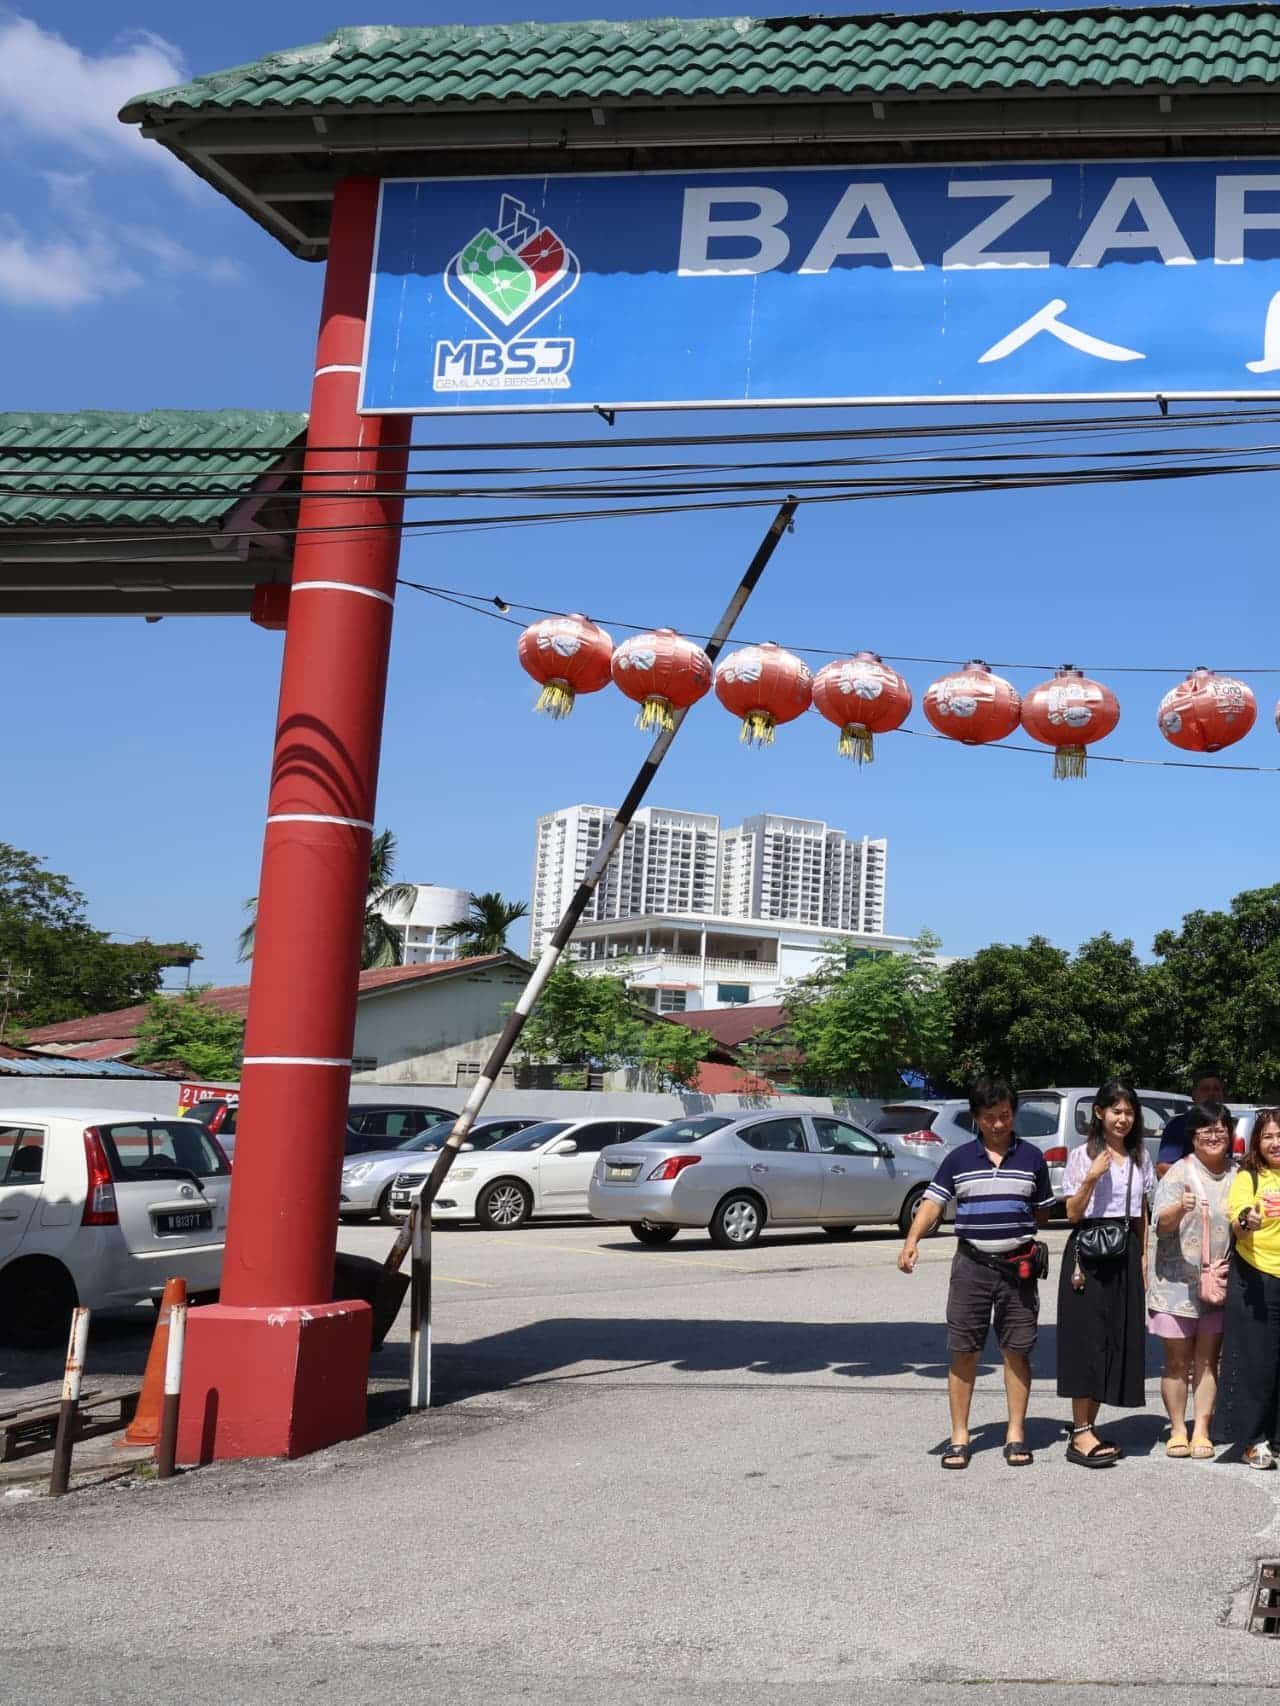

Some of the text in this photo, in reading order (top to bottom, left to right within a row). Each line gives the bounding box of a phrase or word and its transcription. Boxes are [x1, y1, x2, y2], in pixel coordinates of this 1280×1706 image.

[437, 341, 571, 376] MBSJ
[504, 375, 567, 387] BERSAMA
[183, 1088, 190, 1103] 2
